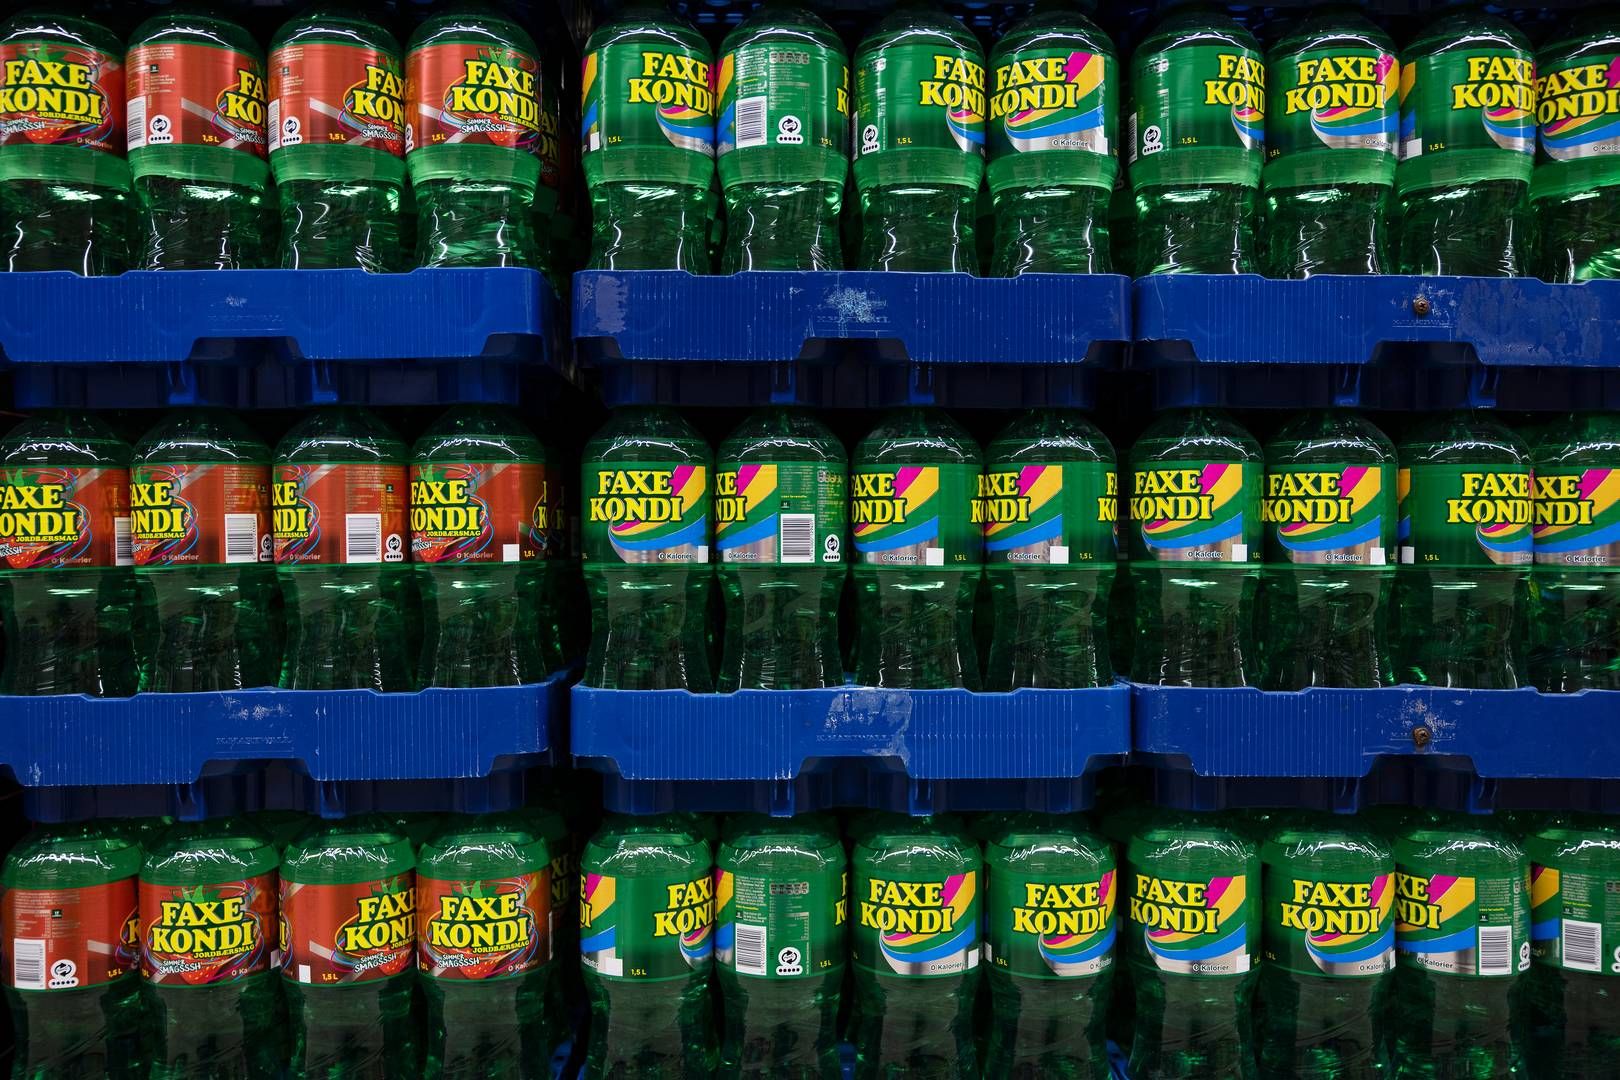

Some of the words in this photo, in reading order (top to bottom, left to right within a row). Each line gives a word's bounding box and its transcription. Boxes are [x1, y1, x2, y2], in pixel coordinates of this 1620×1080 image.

[5, 60, 90, 88] FAXE
[366, 65, 404, 99] FAX
[465, 60, 535, 95] FAXE
[642, 52, 709, 87] FAXE
[996, 58, 1067, 91] FAXE
[1298, 57, 1377, 85] FAXE
[1468, 57, 1532, 85] FAXE
[238, 69, 265, 101] FA
[0, 87, 101, 118] KONDI
[353, 89, 404, 126] KON
[451, 86, 539, 125] KONDI
[920, 81, 984, 118] KOND
[990, 84, 1078, 120] KONDI
[1286, 84, 1385, 114] KONDI
[1538, 90, 1619, 124] ONDI
[37, 111, 102, 124] JORDBÆRSMAG
[1060, 138, 1088, 148] Kalorier
[132, 482, 172, 506] AXE
[273, 482, 297, 505] XE
[599, 472, 672, 494] FAXE
[716, 472, 737, 494] XE
[852, 473, 894, 497] AXE
[984, 472, 1019, 496] AXE
[1134, 470, 1201, 494] FAXE
[1269, 473, 1340, 496] FAXE
[1462, 473, 1530, 497] FAXE
[132, 508, 184, 533] ONDI
[274, 508, 307, 532] NDI
[590, 498, 682, 521] KONDI
[716, 498, 746, 521] NDI
[852, 500, 904, 523] ONDI
[1130, 496, 1212, 520] KONDI
[1263, 499, 1351, 522] KONDI
[1535, 501, 1593, 524] NDI
[0, 512, 78, 537] ONDI
[59, 556, 92, 564] Kalorier
[667, 552, 692, 560] Kalorier
[888, 554, 917, 562] Kalorier
[1014, 552, 1040, 560] Kalorier
[668, 876, 712, 909] FAX
[870, 879, 943, 906] FAXE
[1026, 882, 1100, 908] FAXE
[1136, 874, 1207, 906] FAXE
[1293, 880, 1371, 907] FAXE
[1396, 872, 1429, 902] XE
[162, 897, 244, 926] FAXE
[441, 893, 519, 920] FAXE
[654, 900, 713, 936] KON
[861, 902, 952, 932] KONDI
[1013, 905, 1106, 934] KONDI
[1130, 897, 1218, 932] KONDI
[1281, 903, 1379, 932] KONDI
[1396, 898, 1440, 929] NDI
[152, 921, 254, 953] KONDI
[344, 914, 416, 950] KON
[432, 917, 528, 948] KONDI
[194, 944, 255, 959] JORDBÆRSMAG
[473, 940, 530, 953] JORDBÆRSMAG
[355, 953, 396, 973] SMAGSSSH
[438, 957, 480, 968] SMAGSSSH
[938, 962, 962, 970] Kalorier
[1201, 964, 1230, 972] Kalorier
[1424, 958, 1453, 968] Kalorier
